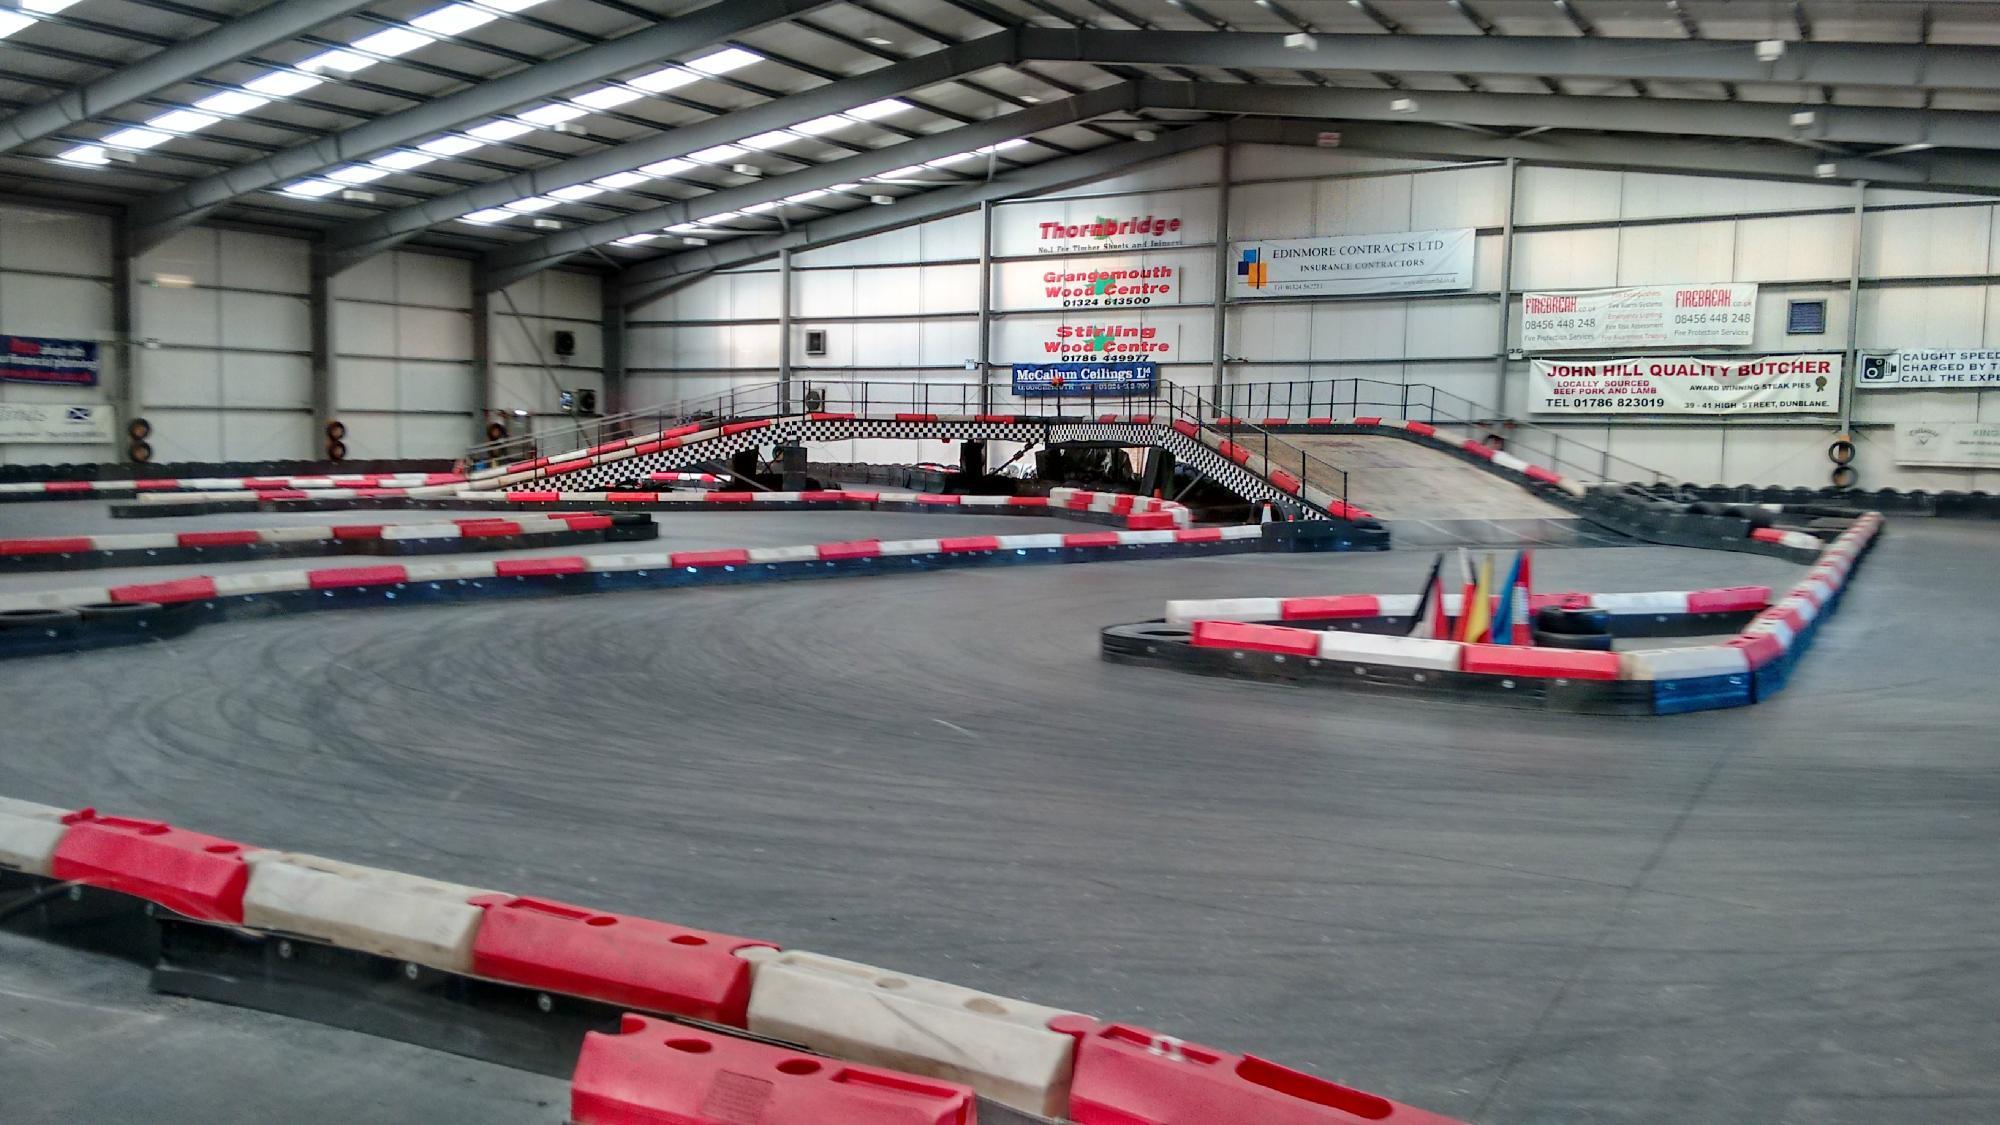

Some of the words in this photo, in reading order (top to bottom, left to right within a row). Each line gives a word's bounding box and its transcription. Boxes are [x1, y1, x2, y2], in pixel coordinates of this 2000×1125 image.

[1040, 216, 1182, 239] Thornbridge
[1273, 246, 1336, 259] EDINMORE
[1339, 243, 1414, 256] CONTRACTS
[1418, 240, 1444, 251] LTD
[1300, 263, 1352, 272] INSURANCE
[1354, 259, 1424, 270] CONTRACTORS
[1044, 266, 1172, 282] Grangemouth
[1045, 285, 1095, 298] Wood
[1104, 283, 1170, 296] Centre
[1064, 299, 1098, 308] 01324
[1104, 297, 1150, 306] 613500
[1526, 296, 1577, 314] FIREBREAK
[1676, 289, 1732, 308] FIREBREAK
[1525, 320, 1554, 330] 08456
[1557, 319, 1574, 328] 448
[1578, 318, 1596, 328] 248
[1674, 314, 1706, 324] 08456
[1709, 314, 1728, 323] 448
[1731, 313, 1751, 322] 248
[1056, 325, 1156, 338] Stirling
[1044, 342, 1094, 352] Wood
[1103, 342, 1170, 352] Centre
[1902, 352, 1956, 360] CAUGHT
[1547, 366, 1596, 377] JOHN
[1602, 364, 1644, 376] HILL
[1649, 364, 1730, 377] QUALITY
[1738, 362, 1830, 377] BUTCHER
[1902, 363, 1964, 372] CHARGED
[1016, 369, 1078, 380] McCallum
[1080, 368, 1132, 382] Ceilings
[1546, 398, 1570, 408] TEL
[1574, 398, 1613, 408] 01786
[1617, 398, 1664, 408] 823019
